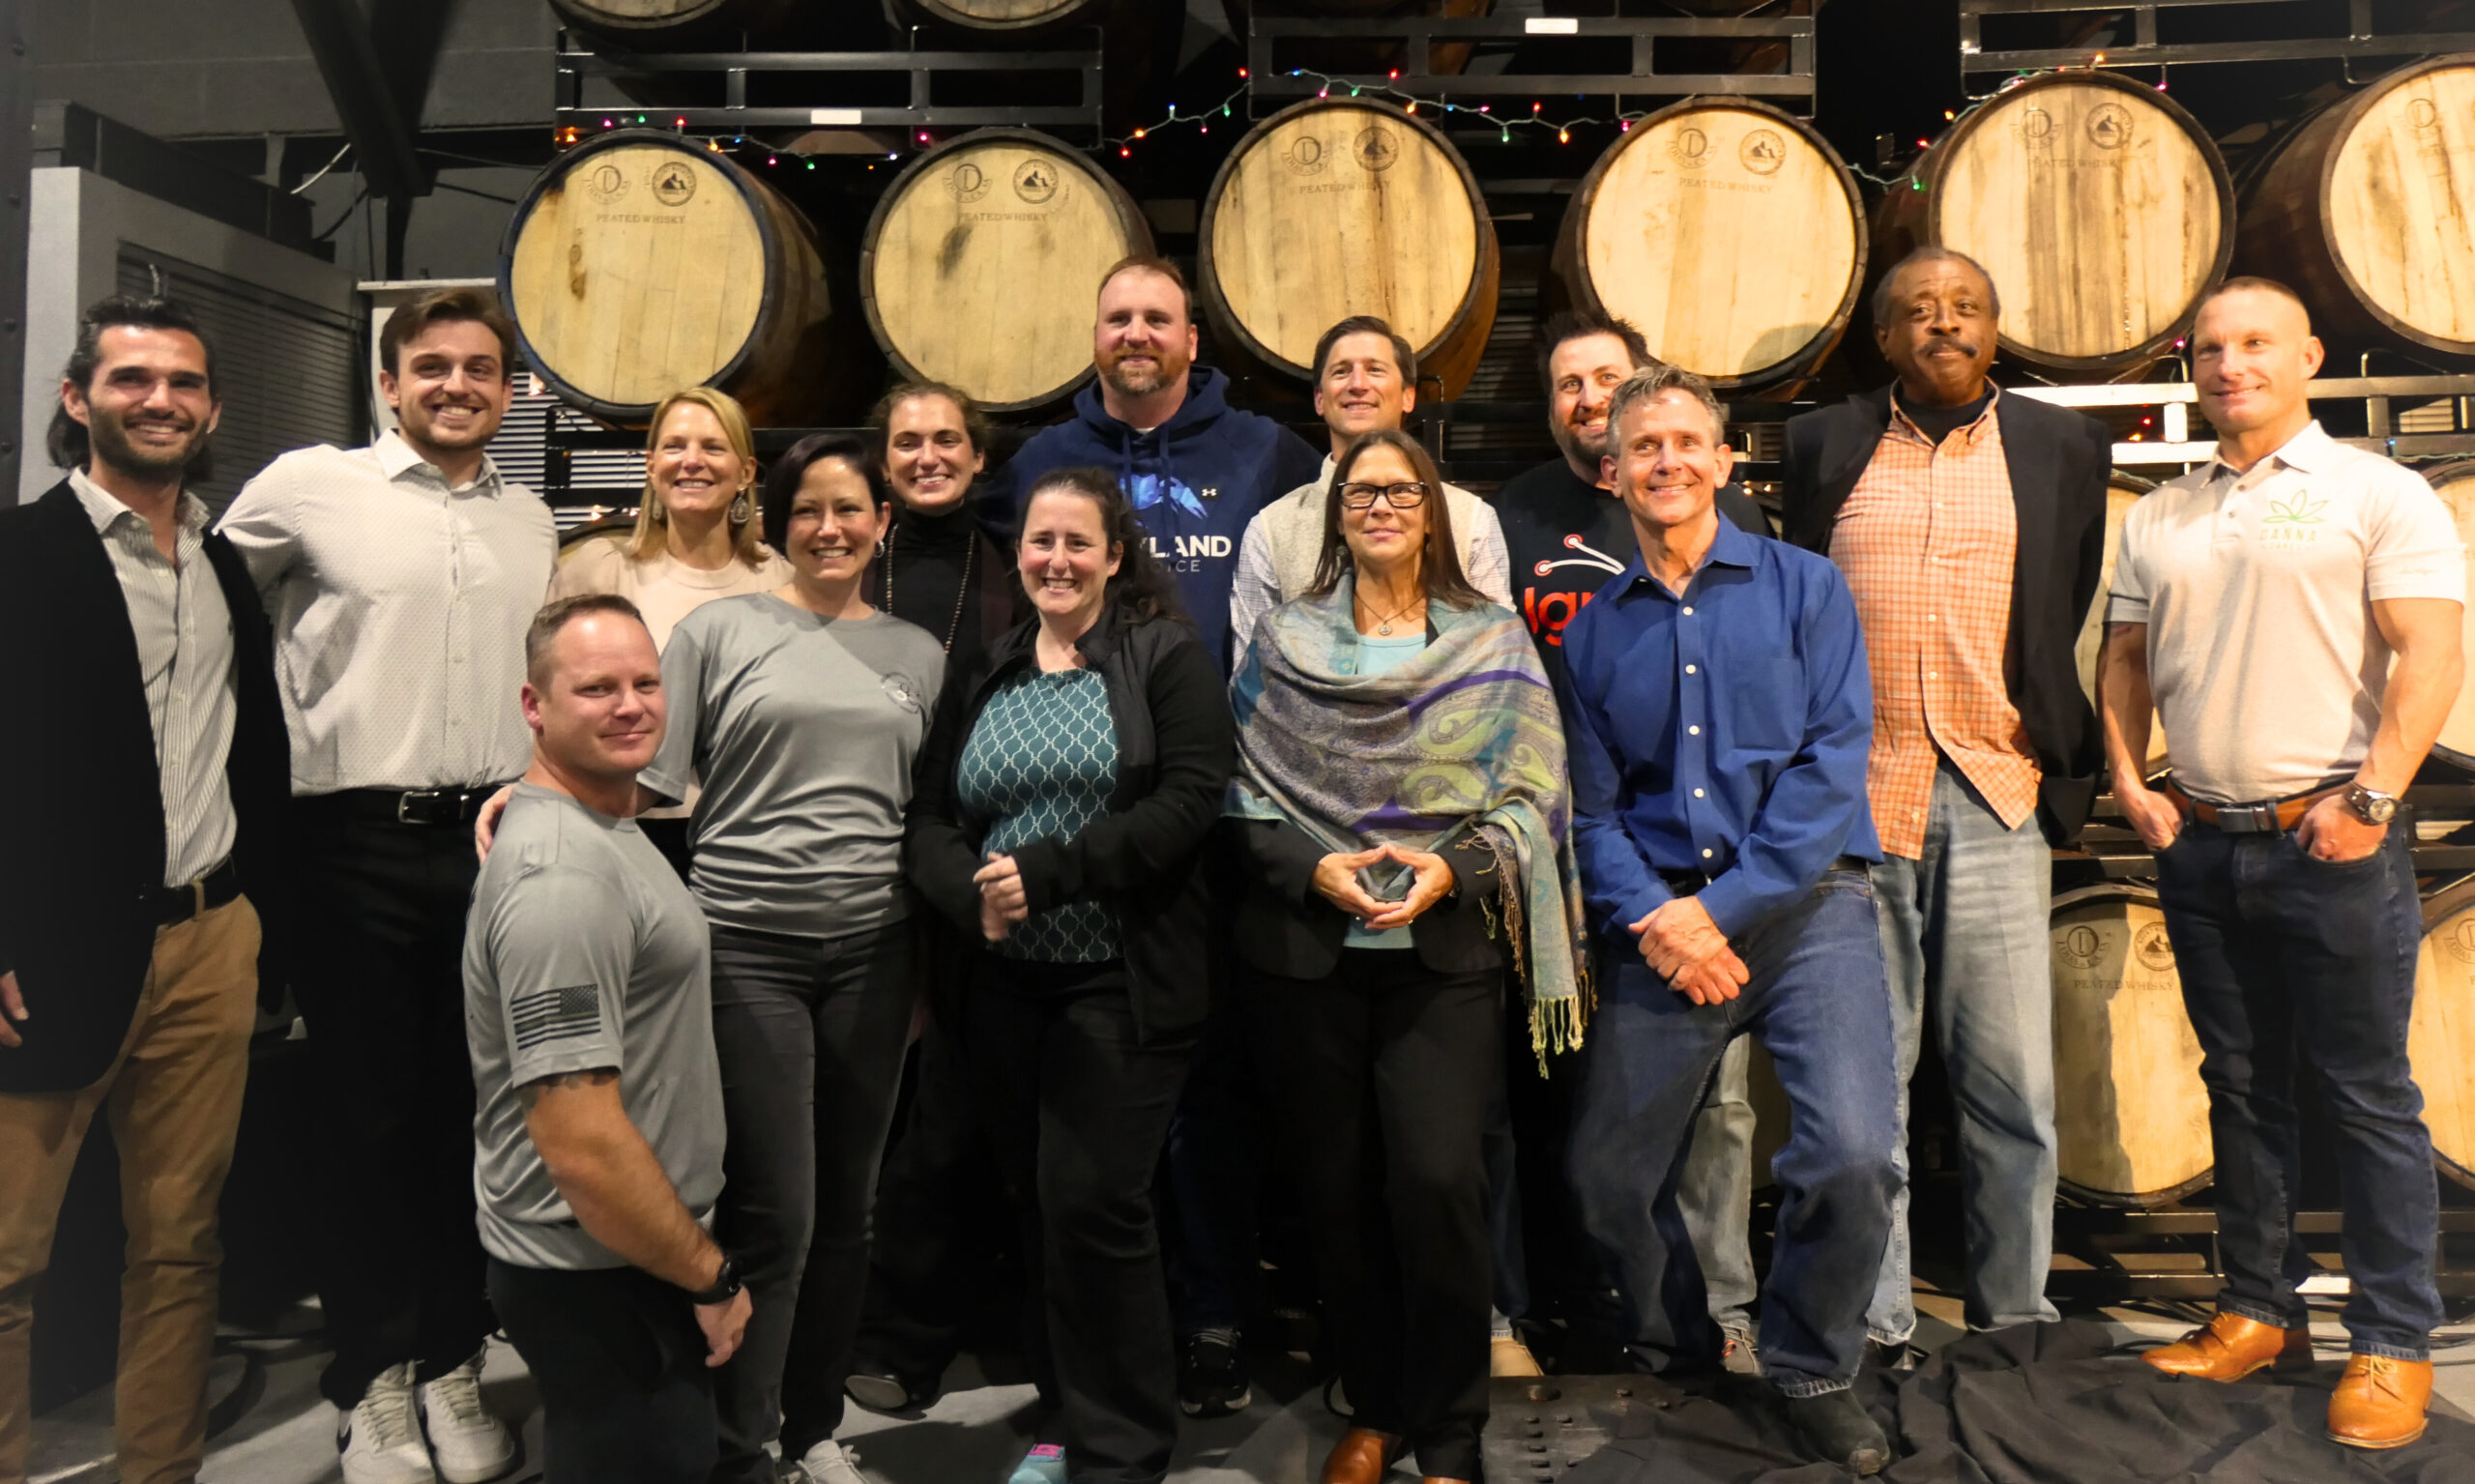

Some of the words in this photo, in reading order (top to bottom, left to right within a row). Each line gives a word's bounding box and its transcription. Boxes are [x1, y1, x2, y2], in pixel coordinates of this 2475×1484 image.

[1299, 183, 1346, 193] PEATED
[1679, 177, 1725, 189] PEATED
[1728, 181, 1771, 193] WHISKY
[596, 214, 640, 223] PEATED
[642, 215, 686, 224] WHISKY
[959, 213, 1002, 222] PEATED
[1004, 213, 1049, 222] WHISKY
[2258, 527, 2317, 542] CANNA
[2074, 978, 2121, 990] PEATED
[2125, 979, 2174, 991] WHISKY
